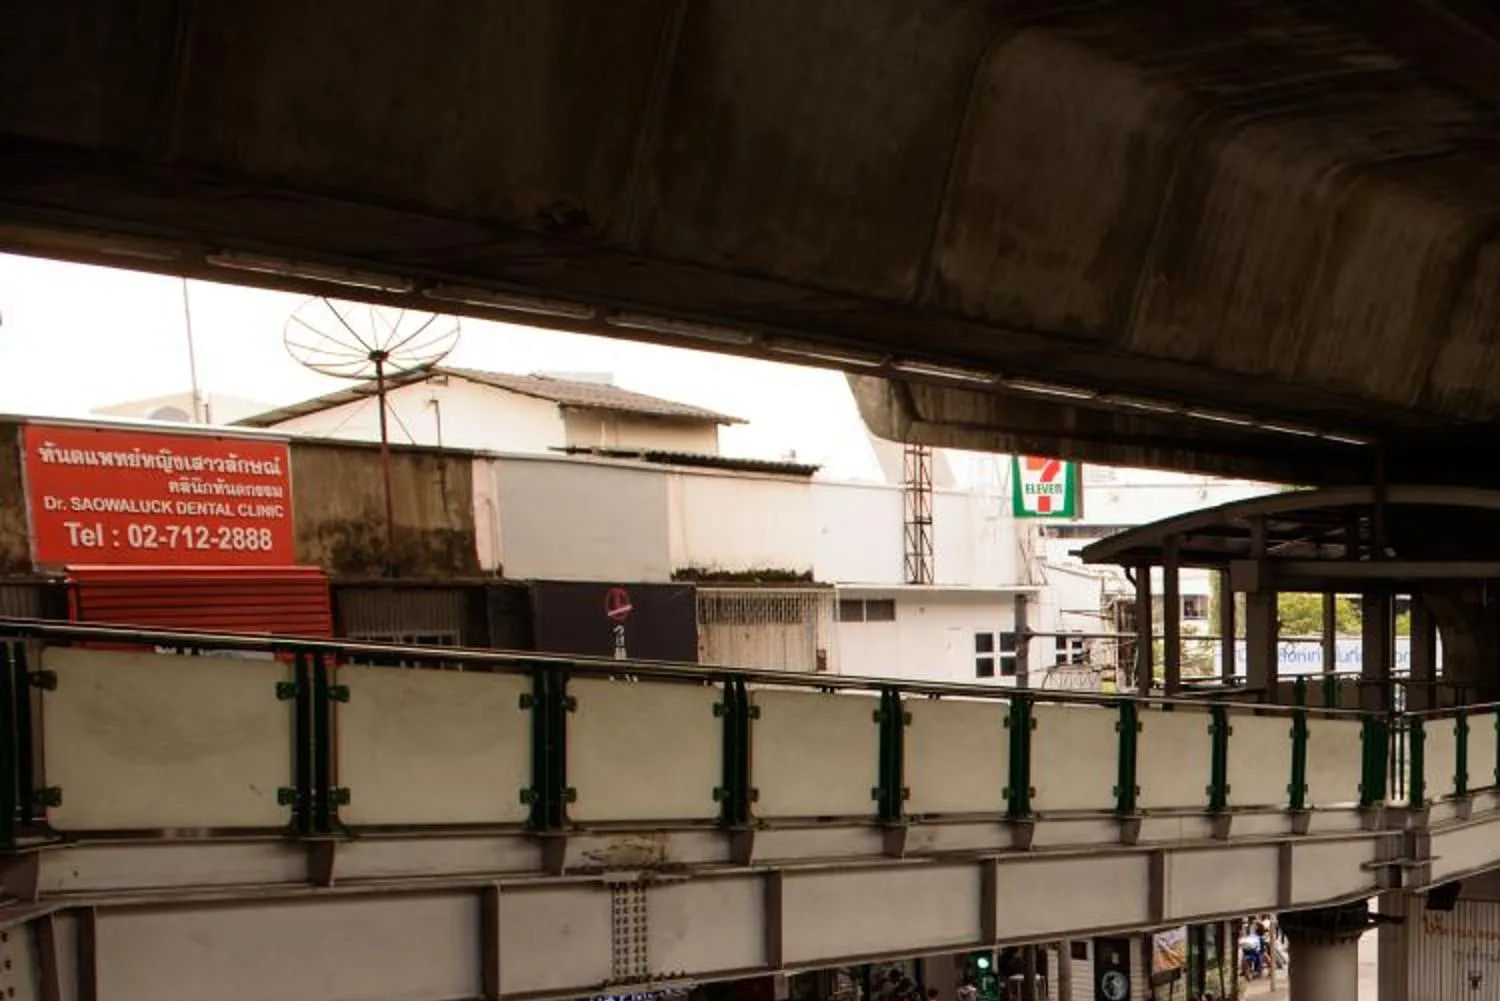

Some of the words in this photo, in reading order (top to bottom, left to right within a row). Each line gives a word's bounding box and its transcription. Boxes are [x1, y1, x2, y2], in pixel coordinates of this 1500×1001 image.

[44, 496, 67, 511] Dr.
[70, 497, 174, 514] SAOWALUCK
[175, 501, 236, 516] DENTAL
[237, 503, 284, 518] CLINIC
[64, 521, 105, 547] Tel
[127, 522, 273, 551] 02-712-2888
